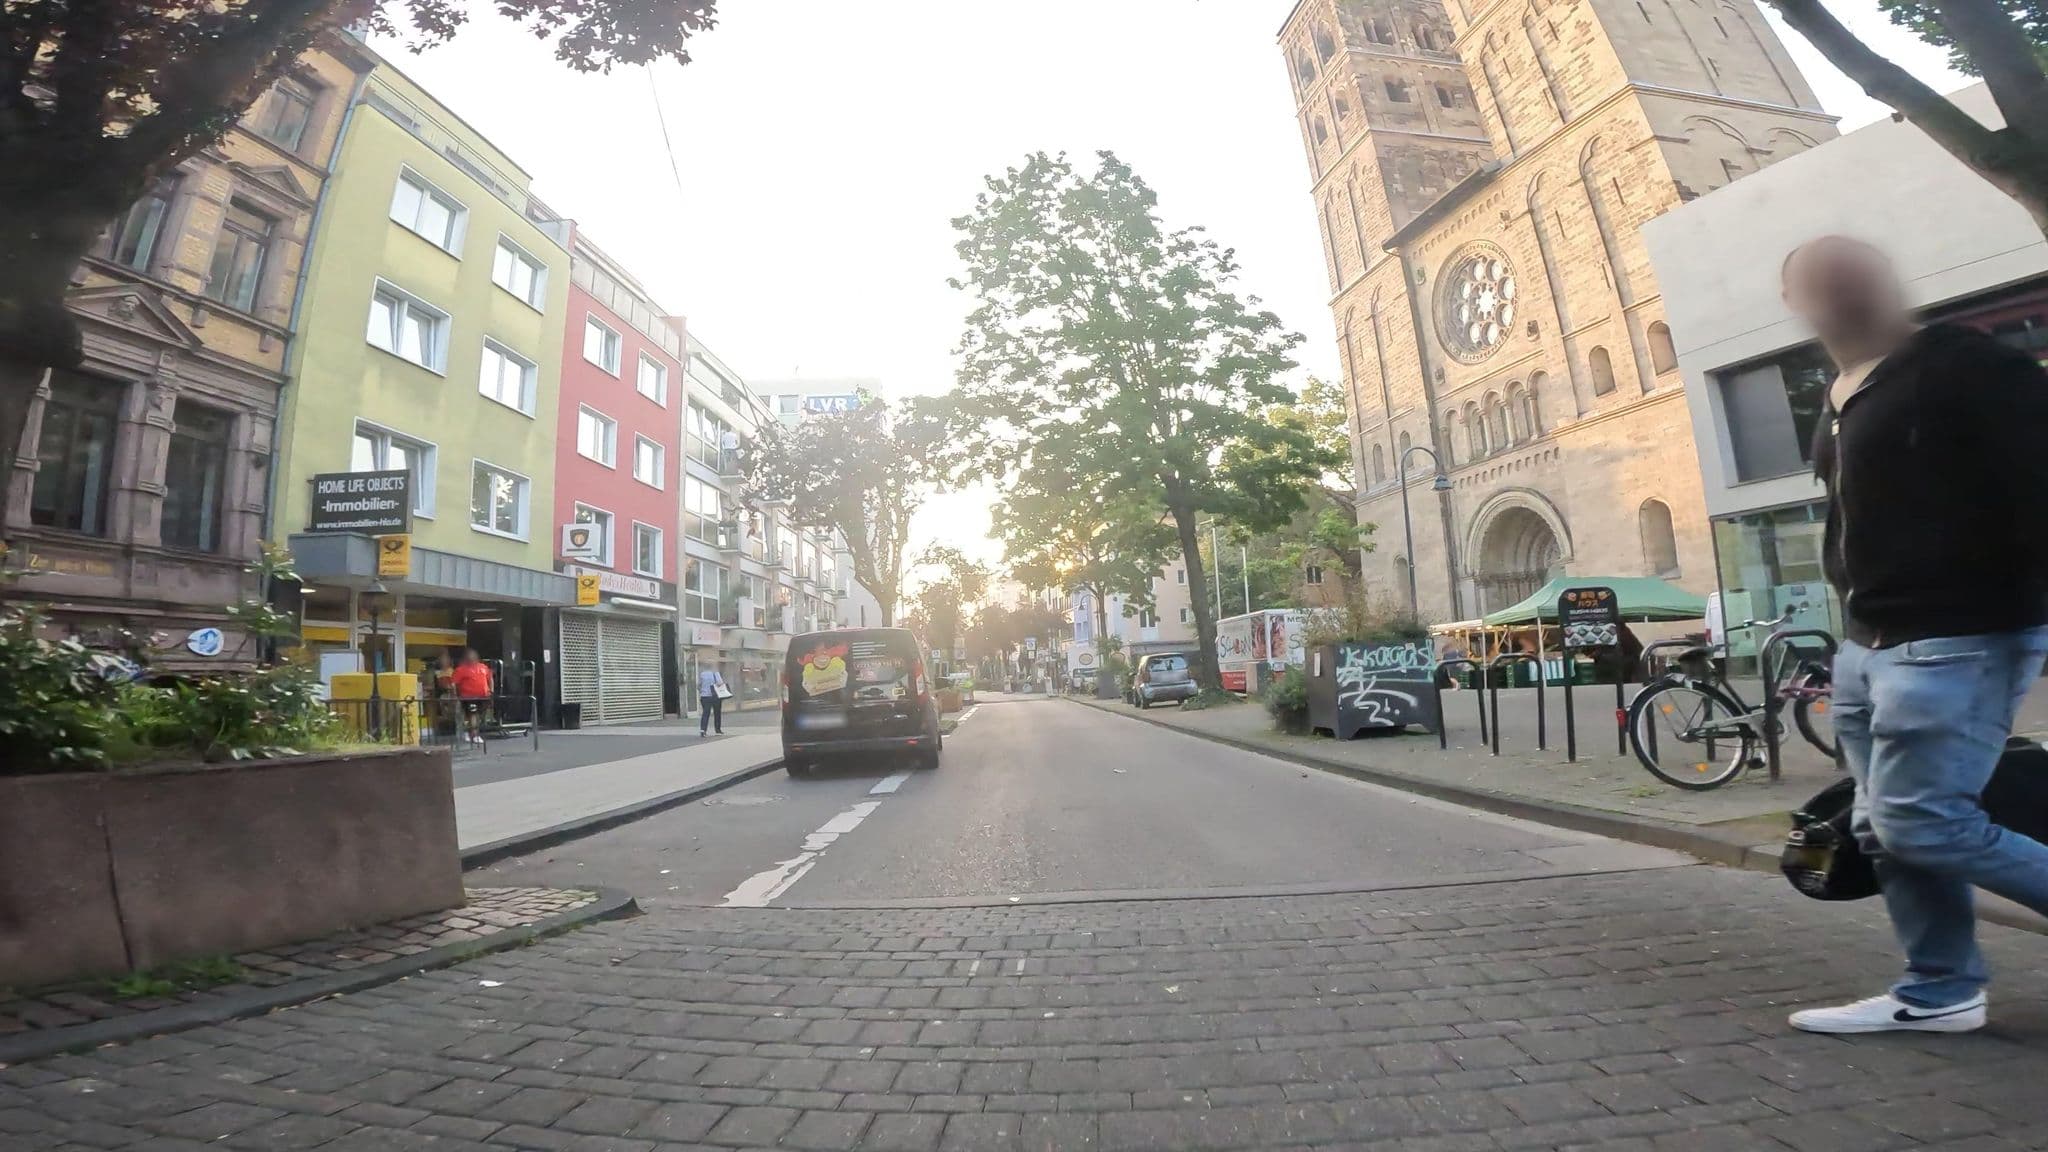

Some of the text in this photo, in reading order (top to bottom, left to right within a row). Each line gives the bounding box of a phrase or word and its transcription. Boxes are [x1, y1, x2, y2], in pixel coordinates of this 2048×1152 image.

[809, 397, 848, 413] LVR
[318, 476, 405, 494] HOME LIFE OBJECTS
